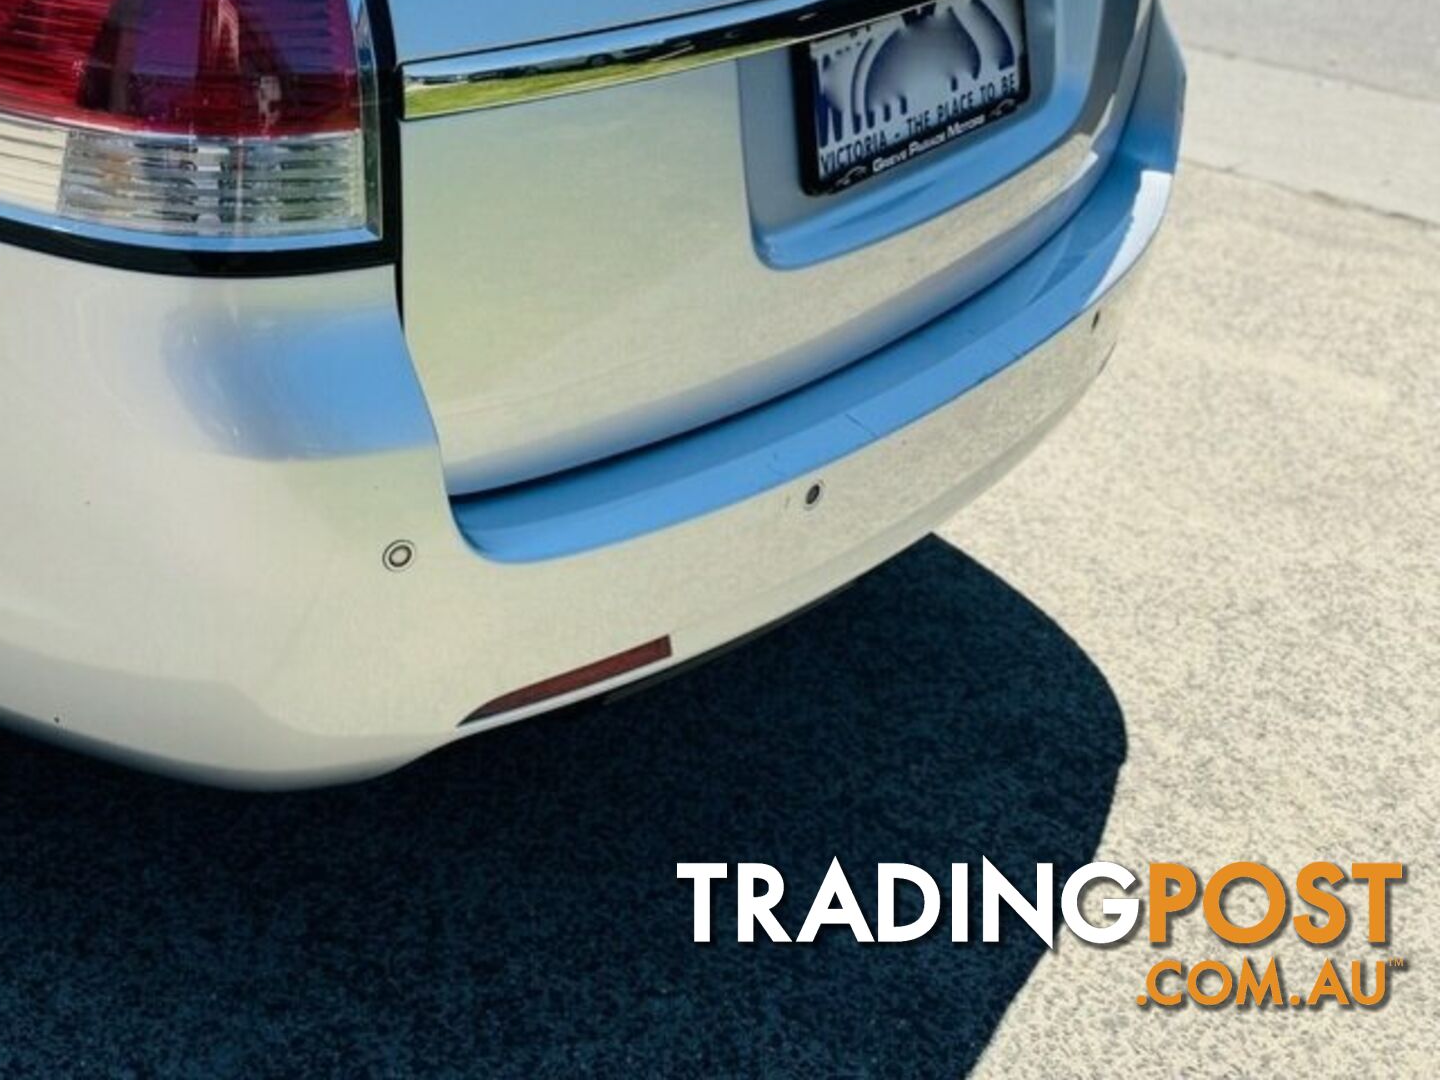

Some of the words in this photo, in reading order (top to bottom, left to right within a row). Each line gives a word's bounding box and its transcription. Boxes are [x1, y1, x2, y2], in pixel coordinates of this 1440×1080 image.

[821, 130, 888, 173] VICTORIA
[907, 110, 931, 137] THE
[937, 91, 974, 122] PLACE
[979, 81, 996, 105] TO
[1001, 73, 1017, 98] BE
